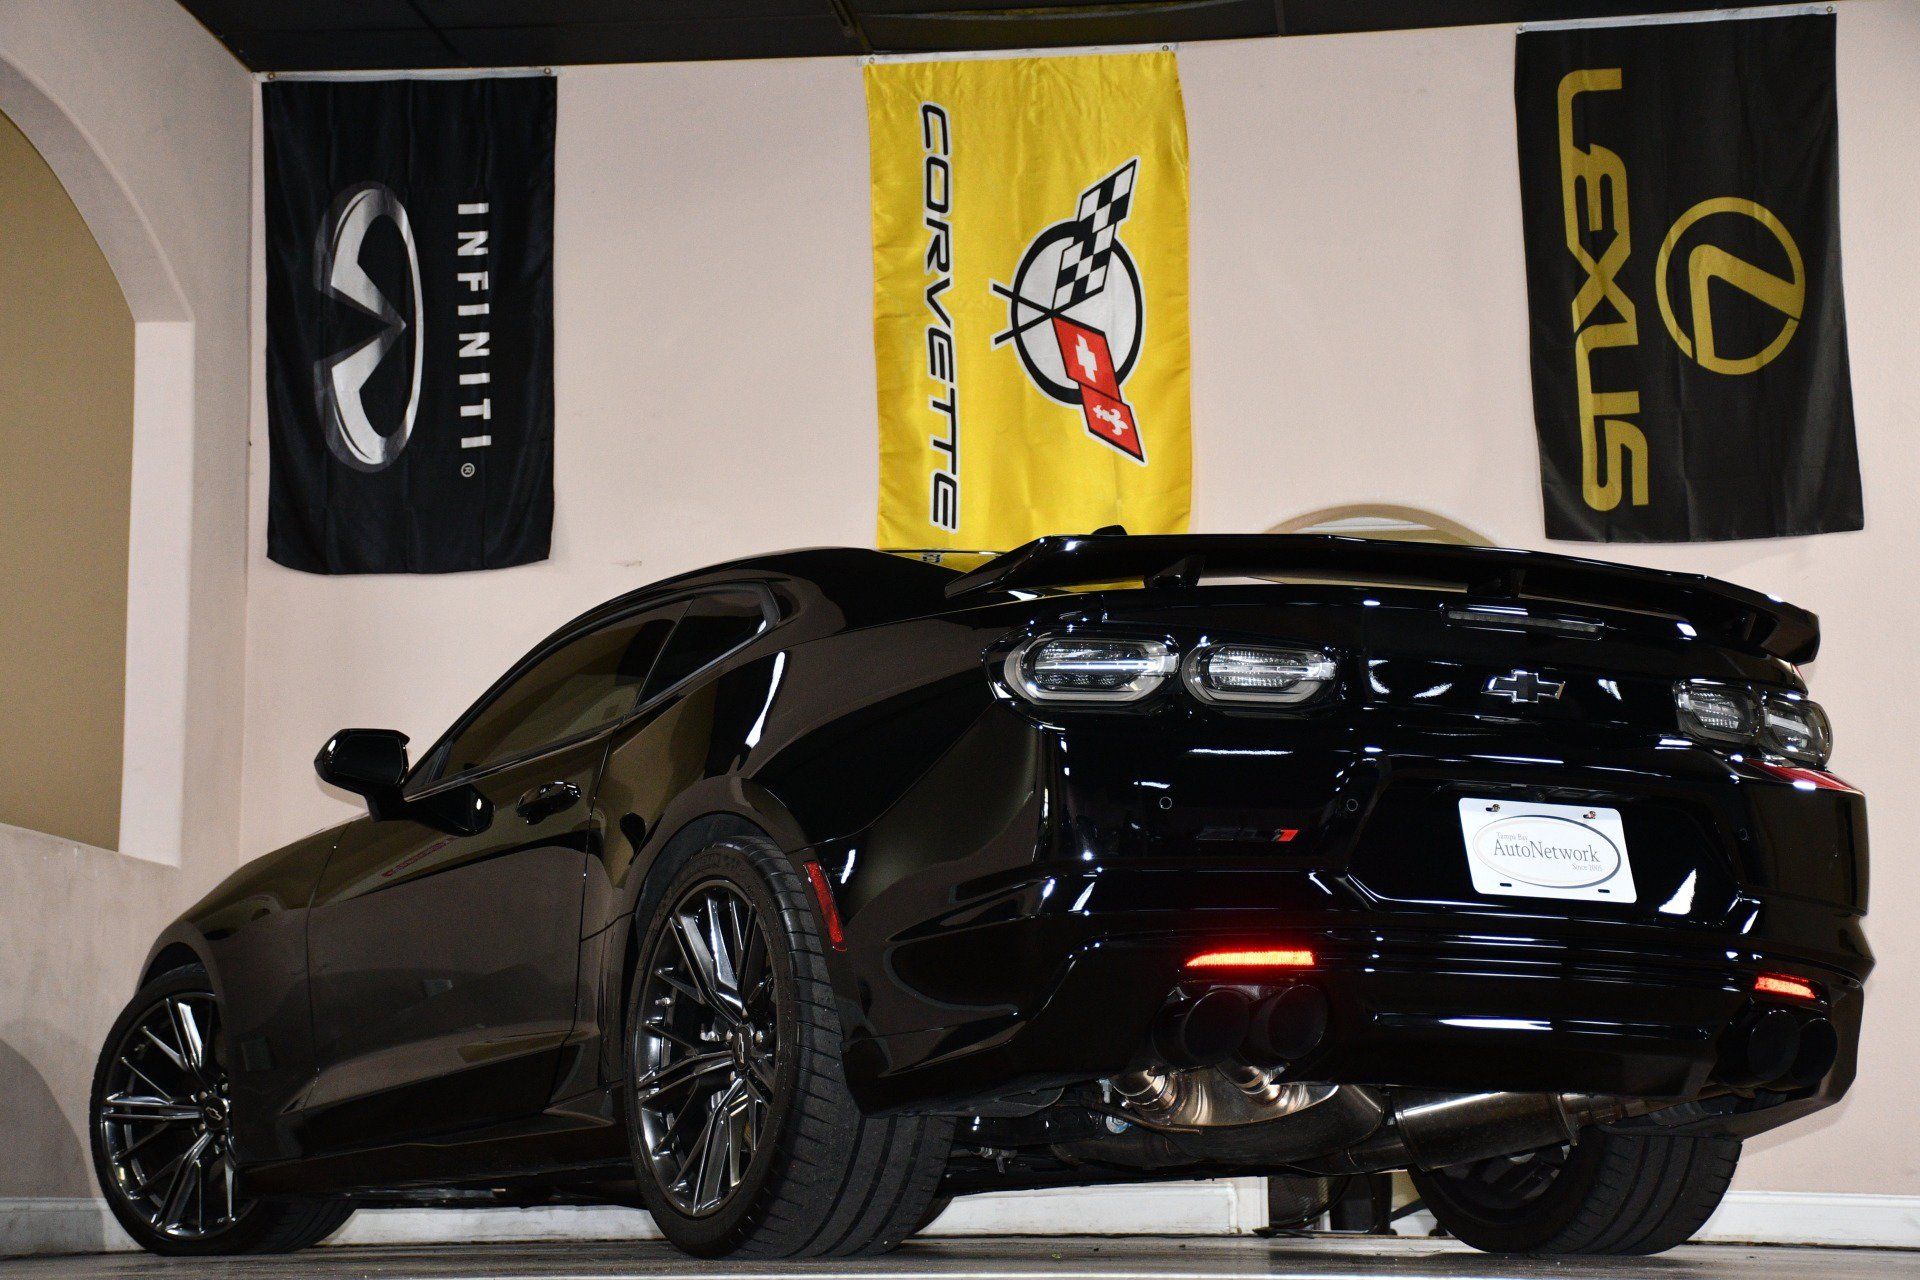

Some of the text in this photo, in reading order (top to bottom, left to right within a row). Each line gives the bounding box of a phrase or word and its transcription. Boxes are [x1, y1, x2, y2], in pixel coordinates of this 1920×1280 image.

[457, 202, 493, 449] INFINITI
[920, 102, 958, 532] CORVETTE
[1557, 67, 1649, 512] LEXUS
[1494, 839, 1601, 862] AutoNetwork
